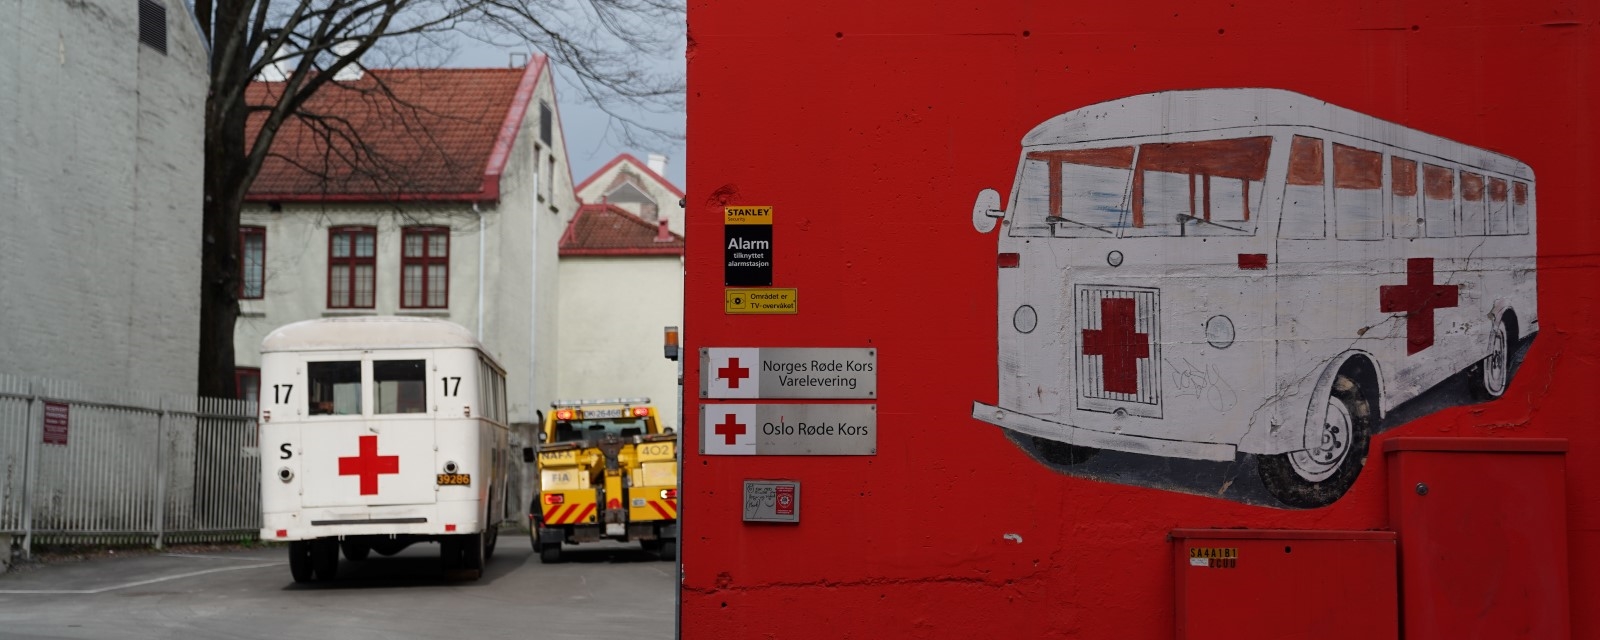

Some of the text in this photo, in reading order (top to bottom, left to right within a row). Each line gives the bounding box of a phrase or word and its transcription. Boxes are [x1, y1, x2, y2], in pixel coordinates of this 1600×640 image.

[727, 237, 769, 250] Alarm
[733, 252, 764, 260] tillknyttet
[727, 260, 769, 268] alarmstasjon
[763, 360, 873, 374] Norges Røde Kors
[441, 377, 462, 397] 17
[778, 375, 857, 389] Varelevering
[273, 384, 293, 404] 17
[763, 422, 868, 435] Oslo Røde Kors
[280, 443, 292, 460] S
[642, 445, 669, 456] 402
[437, 474, 470, 485] 39286
